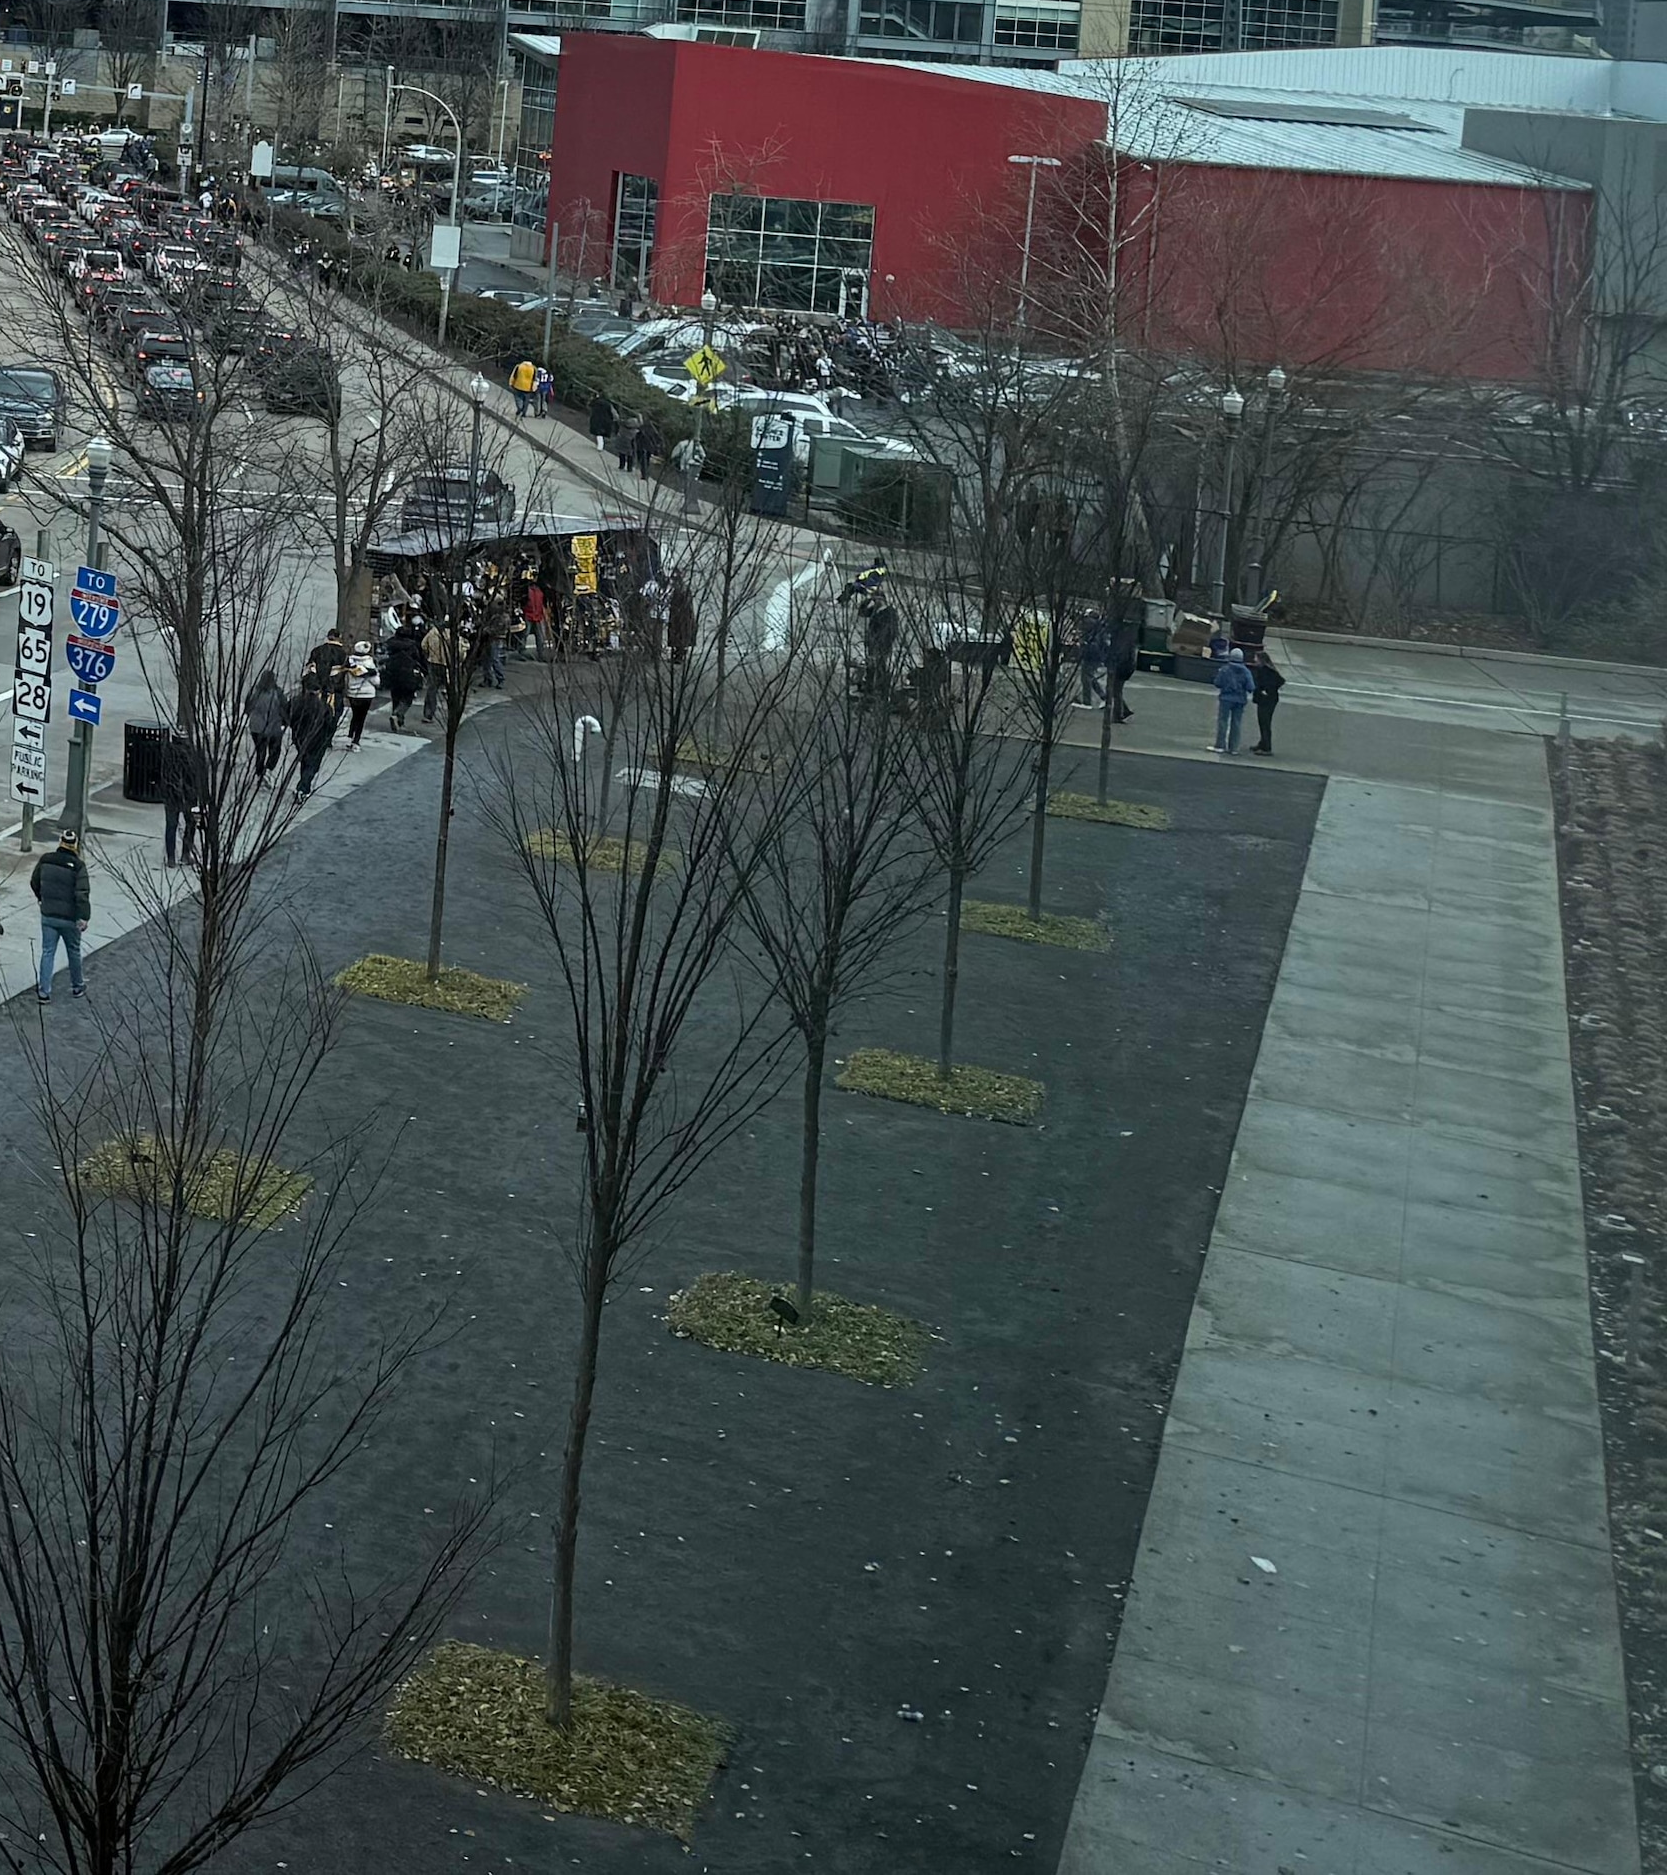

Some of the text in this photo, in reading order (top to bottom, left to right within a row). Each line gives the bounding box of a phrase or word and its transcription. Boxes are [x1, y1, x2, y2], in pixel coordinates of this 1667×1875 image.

[30, 562, 45, 577] TO
[87, 573, 105, 589] TO
[27, 591, 46, 617] 19
[78, 601, 110, 630] 279
[21, 636, 47, 664] 65
[72, 647, 107, 678] 376
[18, 681, 46, 710] 28
[11, 763, 45, 782] PARKING
